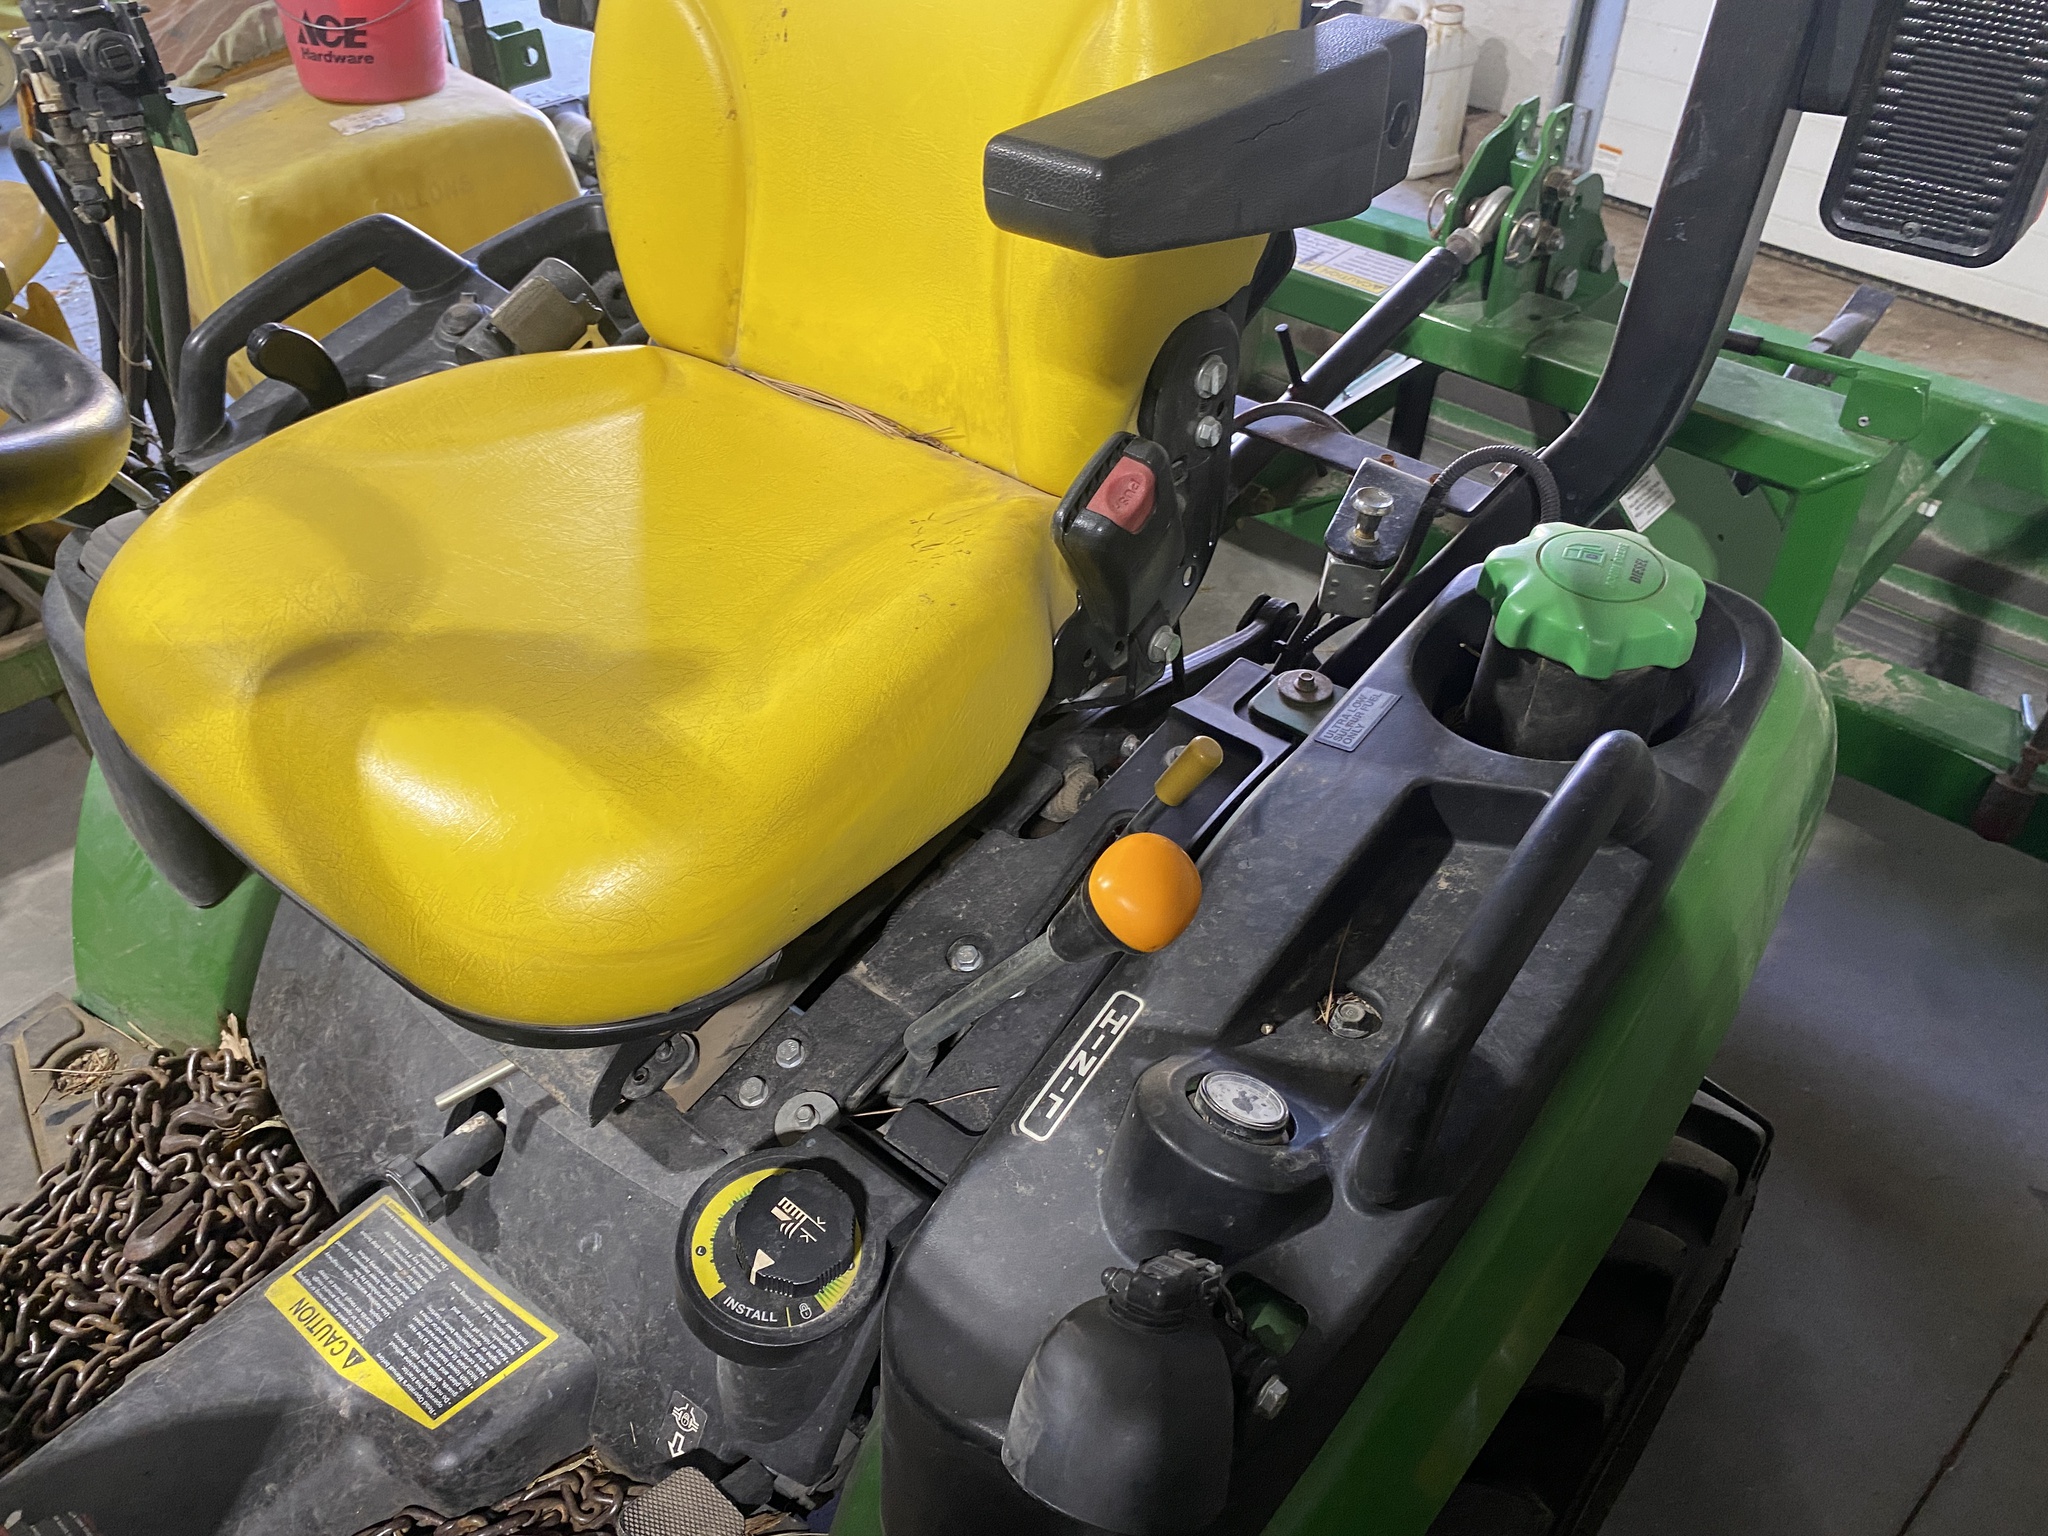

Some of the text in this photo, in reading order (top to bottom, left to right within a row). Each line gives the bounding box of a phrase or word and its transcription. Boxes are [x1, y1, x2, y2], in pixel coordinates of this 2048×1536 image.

[298, 10, 367, 48] ACE
[301, 48, 374, 64] Hardware
[1629, 557, 1649, 585] DIESEL
[1323, 693, 1369, 739] ULTRA LOW
[1333, 693, 1384, 742] SULFUR FUEL
[1343, 724, 1366, 745] ONLY
[1046, 1008, 1129, 1119] H N L
[333, 1239, 349, 1254] ground
[368, 1239, 381, 1250] stop
[355, 1249, 370, 1262] before
[381, 1251, 403, 1272] movement
[367, 1259, 386, 1277] securely
[358, 1274, 367, 1282] by
[366, 1272, 380, 1285] lower
[382, 1274, 396, 1287] brake
[410, 1279, 422, 1290] Wait
[320, 1285, 335, 1299] around
[330, 1282, 347, 1298] ground
[350, 1278, 369, 1295] warning
[362, 1278, 386, 1299] prohibited
[392, 1284, 402, 1293] set
[449, 1279, 463, 1292] away
[342, 1294, 358, 1308] rough
[390, 1294, 404, 1306] Stop
[399, 1291, 410, 1300] and
[458, 1289, 478, 1307] clothing
[325, 1301, 338, 1314] when
[332, 1296, 354, 1316] operating
[381, 1297, 397, 1311] unless
[450, 1305, 461, 1315] and
[473, 1305, 485, 1315] and
[723, 1296, 778, 1322] INSTALL
[335, 1310, 351, 1325] speed
[379, 1307, 390, 1317] Use
[417, 1309, 433, 1324] others
[424, 1304, 443, 1321] starting
[481, 1312, 493, 1322] feet
[491, 1310, 507, 1324] driven
[289, 1296, 349, 1356] CAUTION
[354, 1318, 370, 1333] brakes
[407, 1323, 418, 1332] rear
[439, 1319, 455, 1333] before
[457, 1313, 474, 1328] tractor
[346, 1323, 363, 1339] Reduce
[505, 1321, 521, 1335] power
[414, 1331, 424, 1340] the
[422, 1326, 442, 1345] rearward
[442, 1333, 462, 1351] children
[451, 1331, 471, 1349] machine
[458, 1325, 484, 1348] operation.
[477, 1331, 492, 1345] riders
[516, 1333, 529, 1345] from
[425, 1341, 439, 1353] only
[439, 1342, 453, 1355] avoid
[508, 1337, 524, 1350] Keep
[421, 1348, 442, 1368] working.
[434, 1350, 449, 1364] loads
[458, 1349, 476, 1364] certain
[473, 1352, 487, 1364] clear
[484, 1349, 503, 1366] engine
[494, 1347, 510, 1361] Keep
[390, 1332, 459, 1397] guards, shields and safety devices
[445, 1361, 461, 1376] towed
[455, 1357, 470, 1370] plate
[472, 1362, 488, 1375] Make
[485, 1362, 494, 1370] are
[387, 1341, 450, 1402] Do not operate machine without
[437, 1366, 449, 1376] and
[465, 1368, 479, 1380] hitch
[374, 1352, 435, 1413] Read Operator's Manual before
[399, 1365, 445, 1408] operating this tractor.
[446, 1373, 462, 1387] place
[458, 1373, 472, 1386] Hitch
